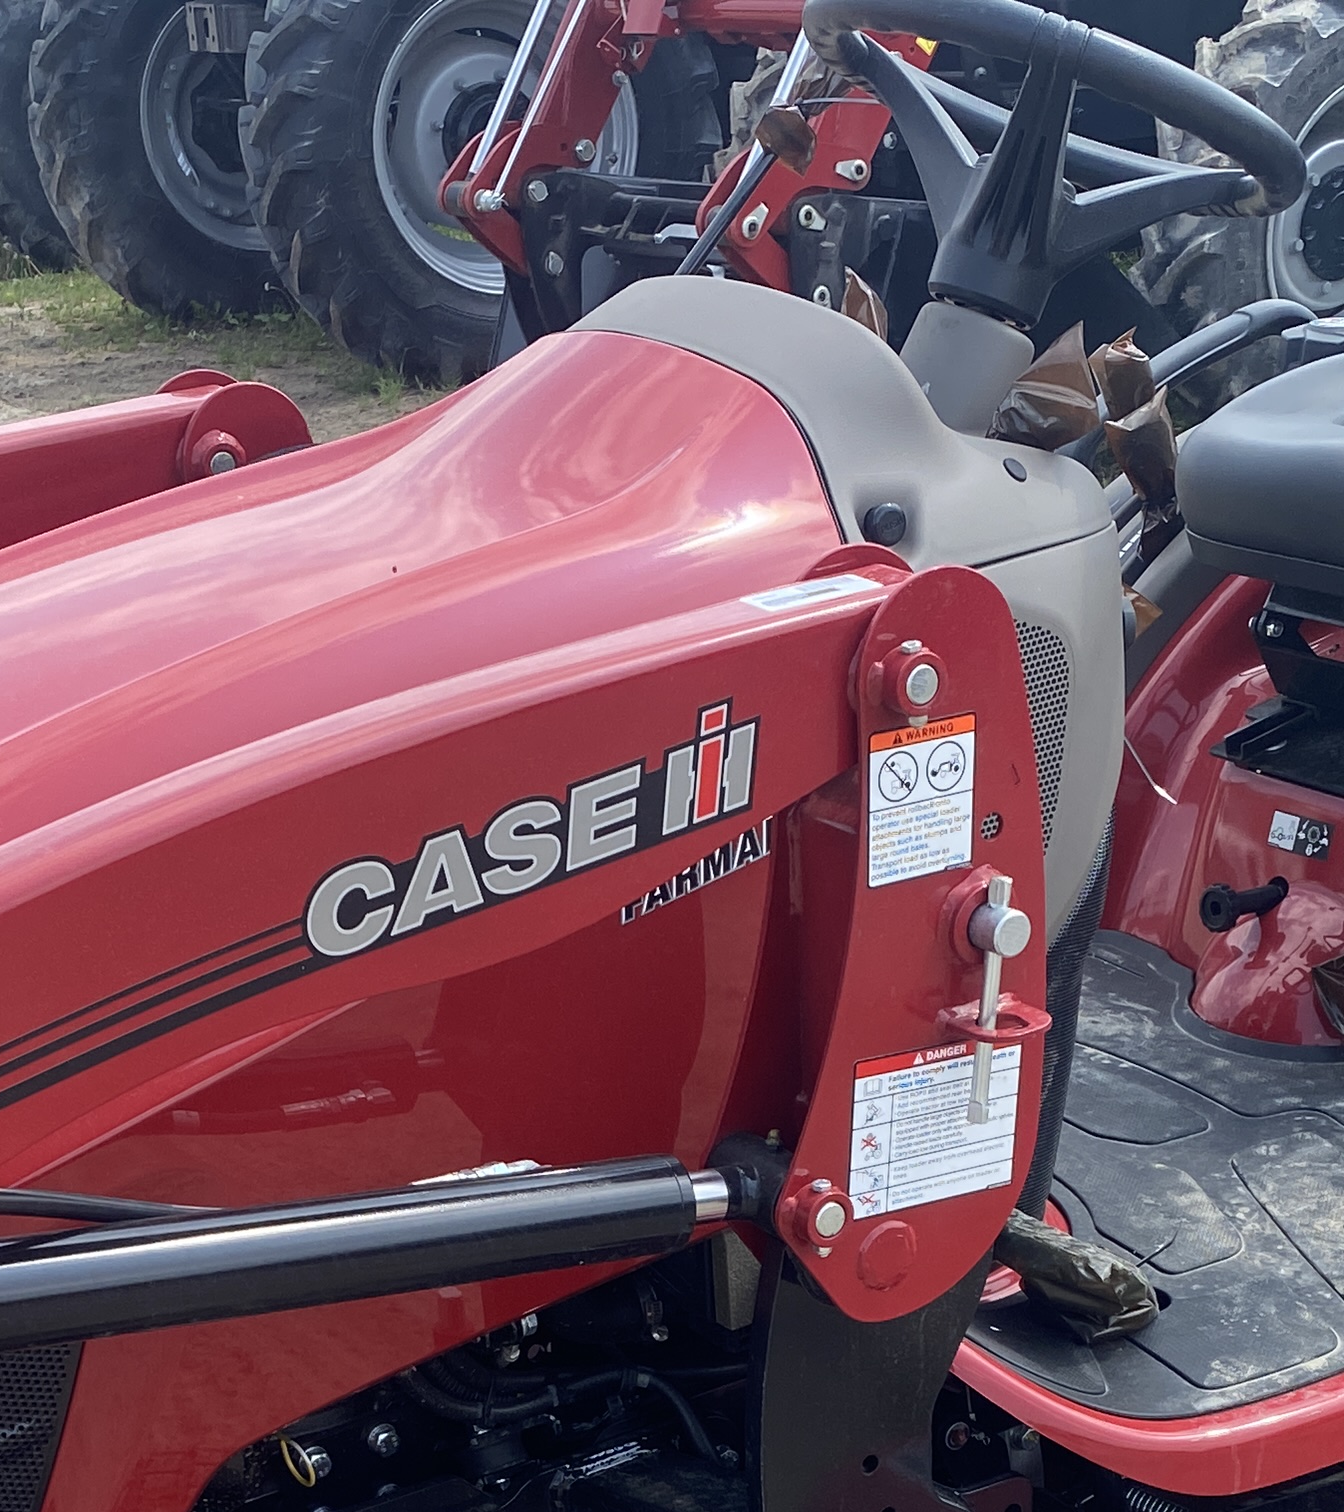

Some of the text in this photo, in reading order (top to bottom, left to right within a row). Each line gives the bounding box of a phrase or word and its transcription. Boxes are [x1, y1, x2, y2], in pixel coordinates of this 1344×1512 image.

[905, 722, 954, 741] WARNING
[305, 762, 643, 957] CASE
[926, 1044, 967, 1062] DANGER
